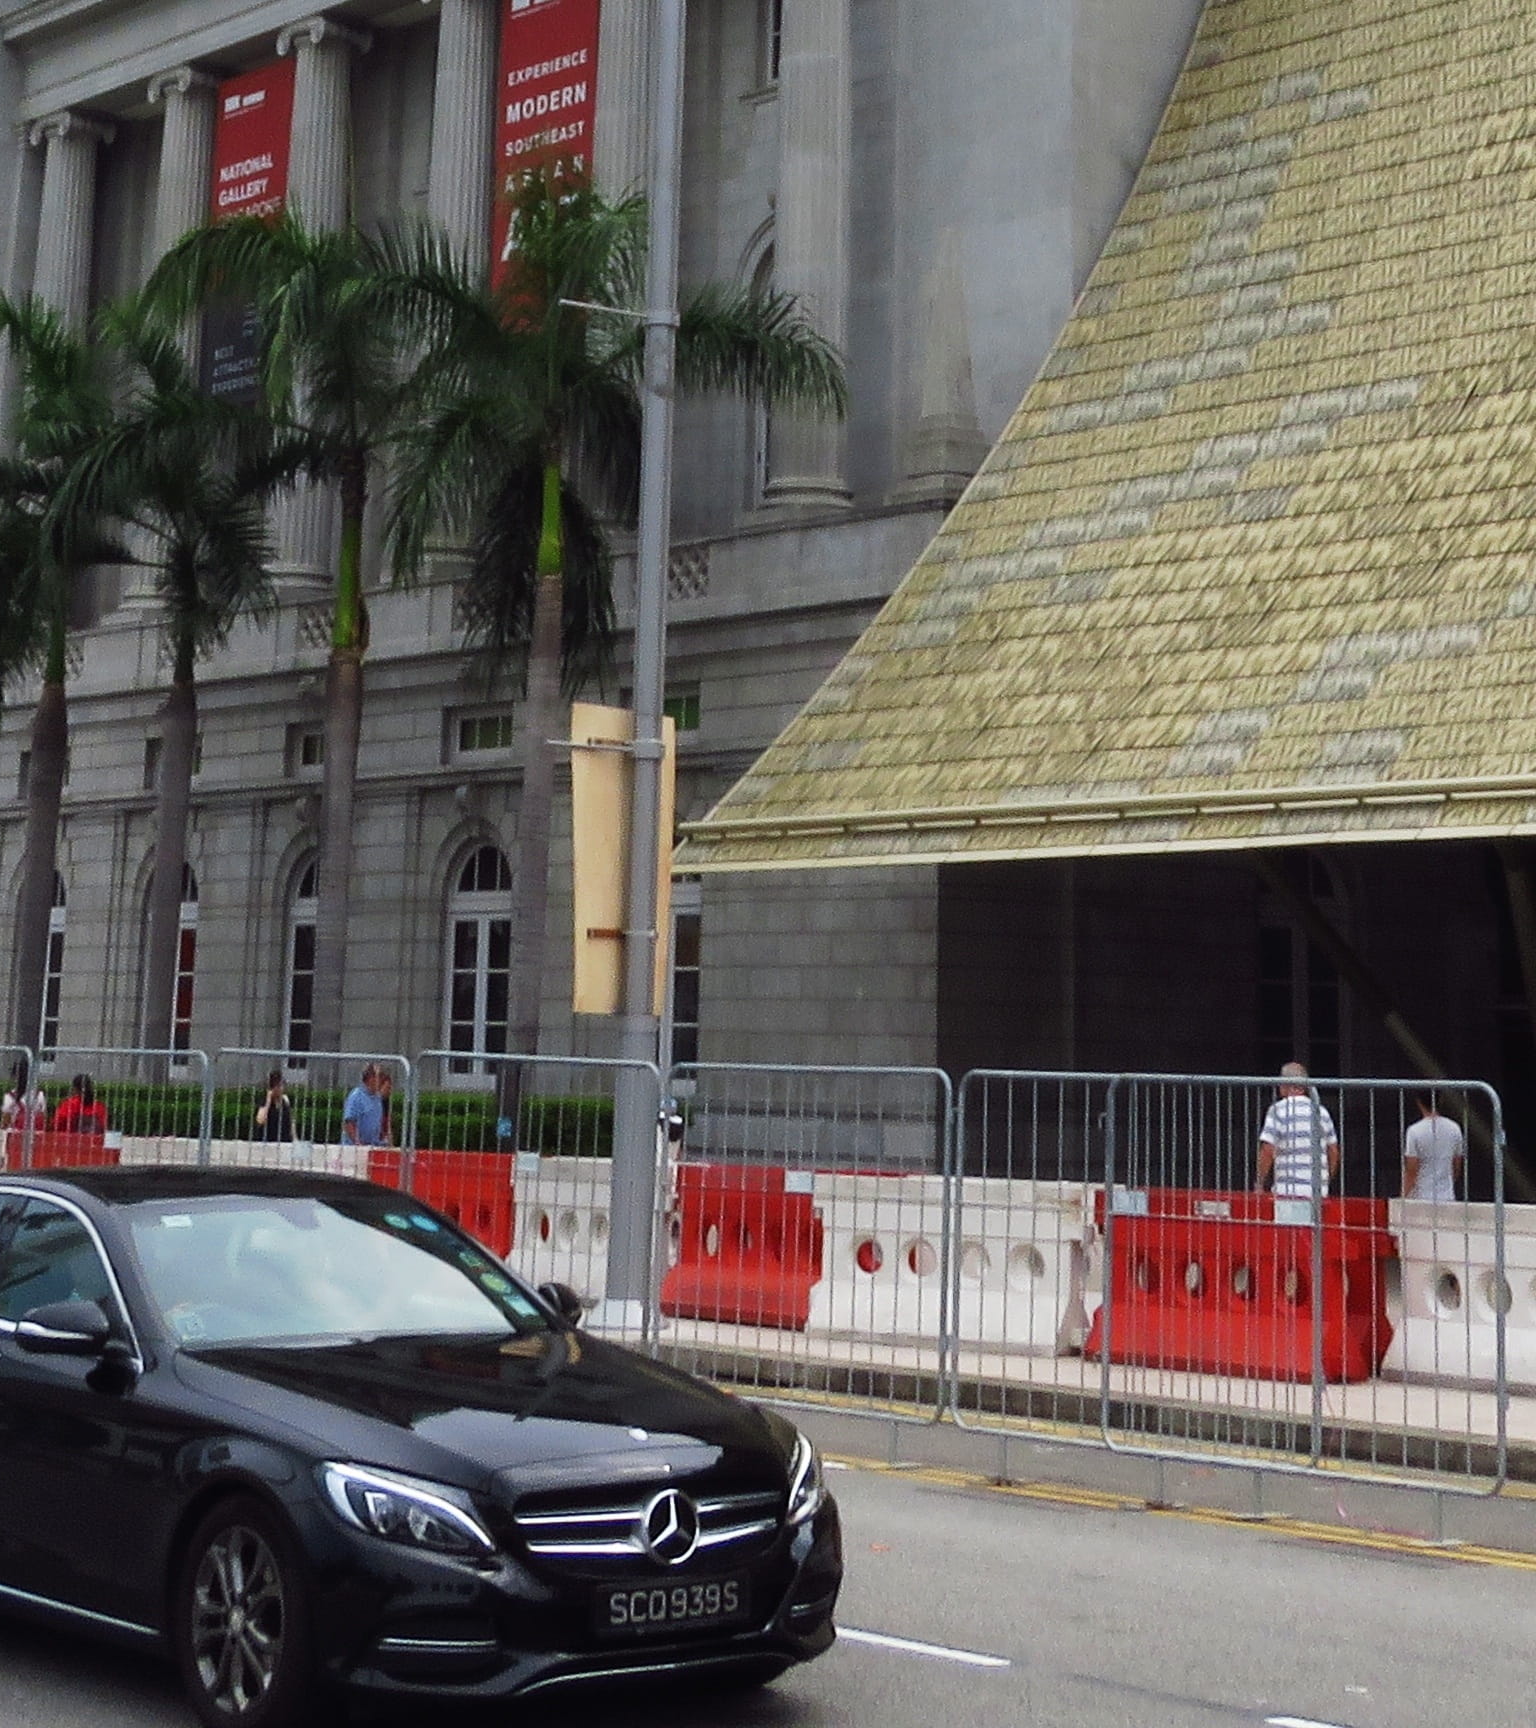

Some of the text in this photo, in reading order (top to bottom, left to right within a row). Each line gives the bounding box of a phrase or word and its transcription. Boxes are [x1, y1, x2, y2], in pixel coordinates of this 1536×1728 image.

[508, 49, 587, 86] EXPERIENCE
[506, 82, 586, 124] MODERN
[505, 121, 584, 157] SOUTHEAST
[219, 152, 273, 182] NATIONAL
[218, 178, 269, 206] GALLERY
